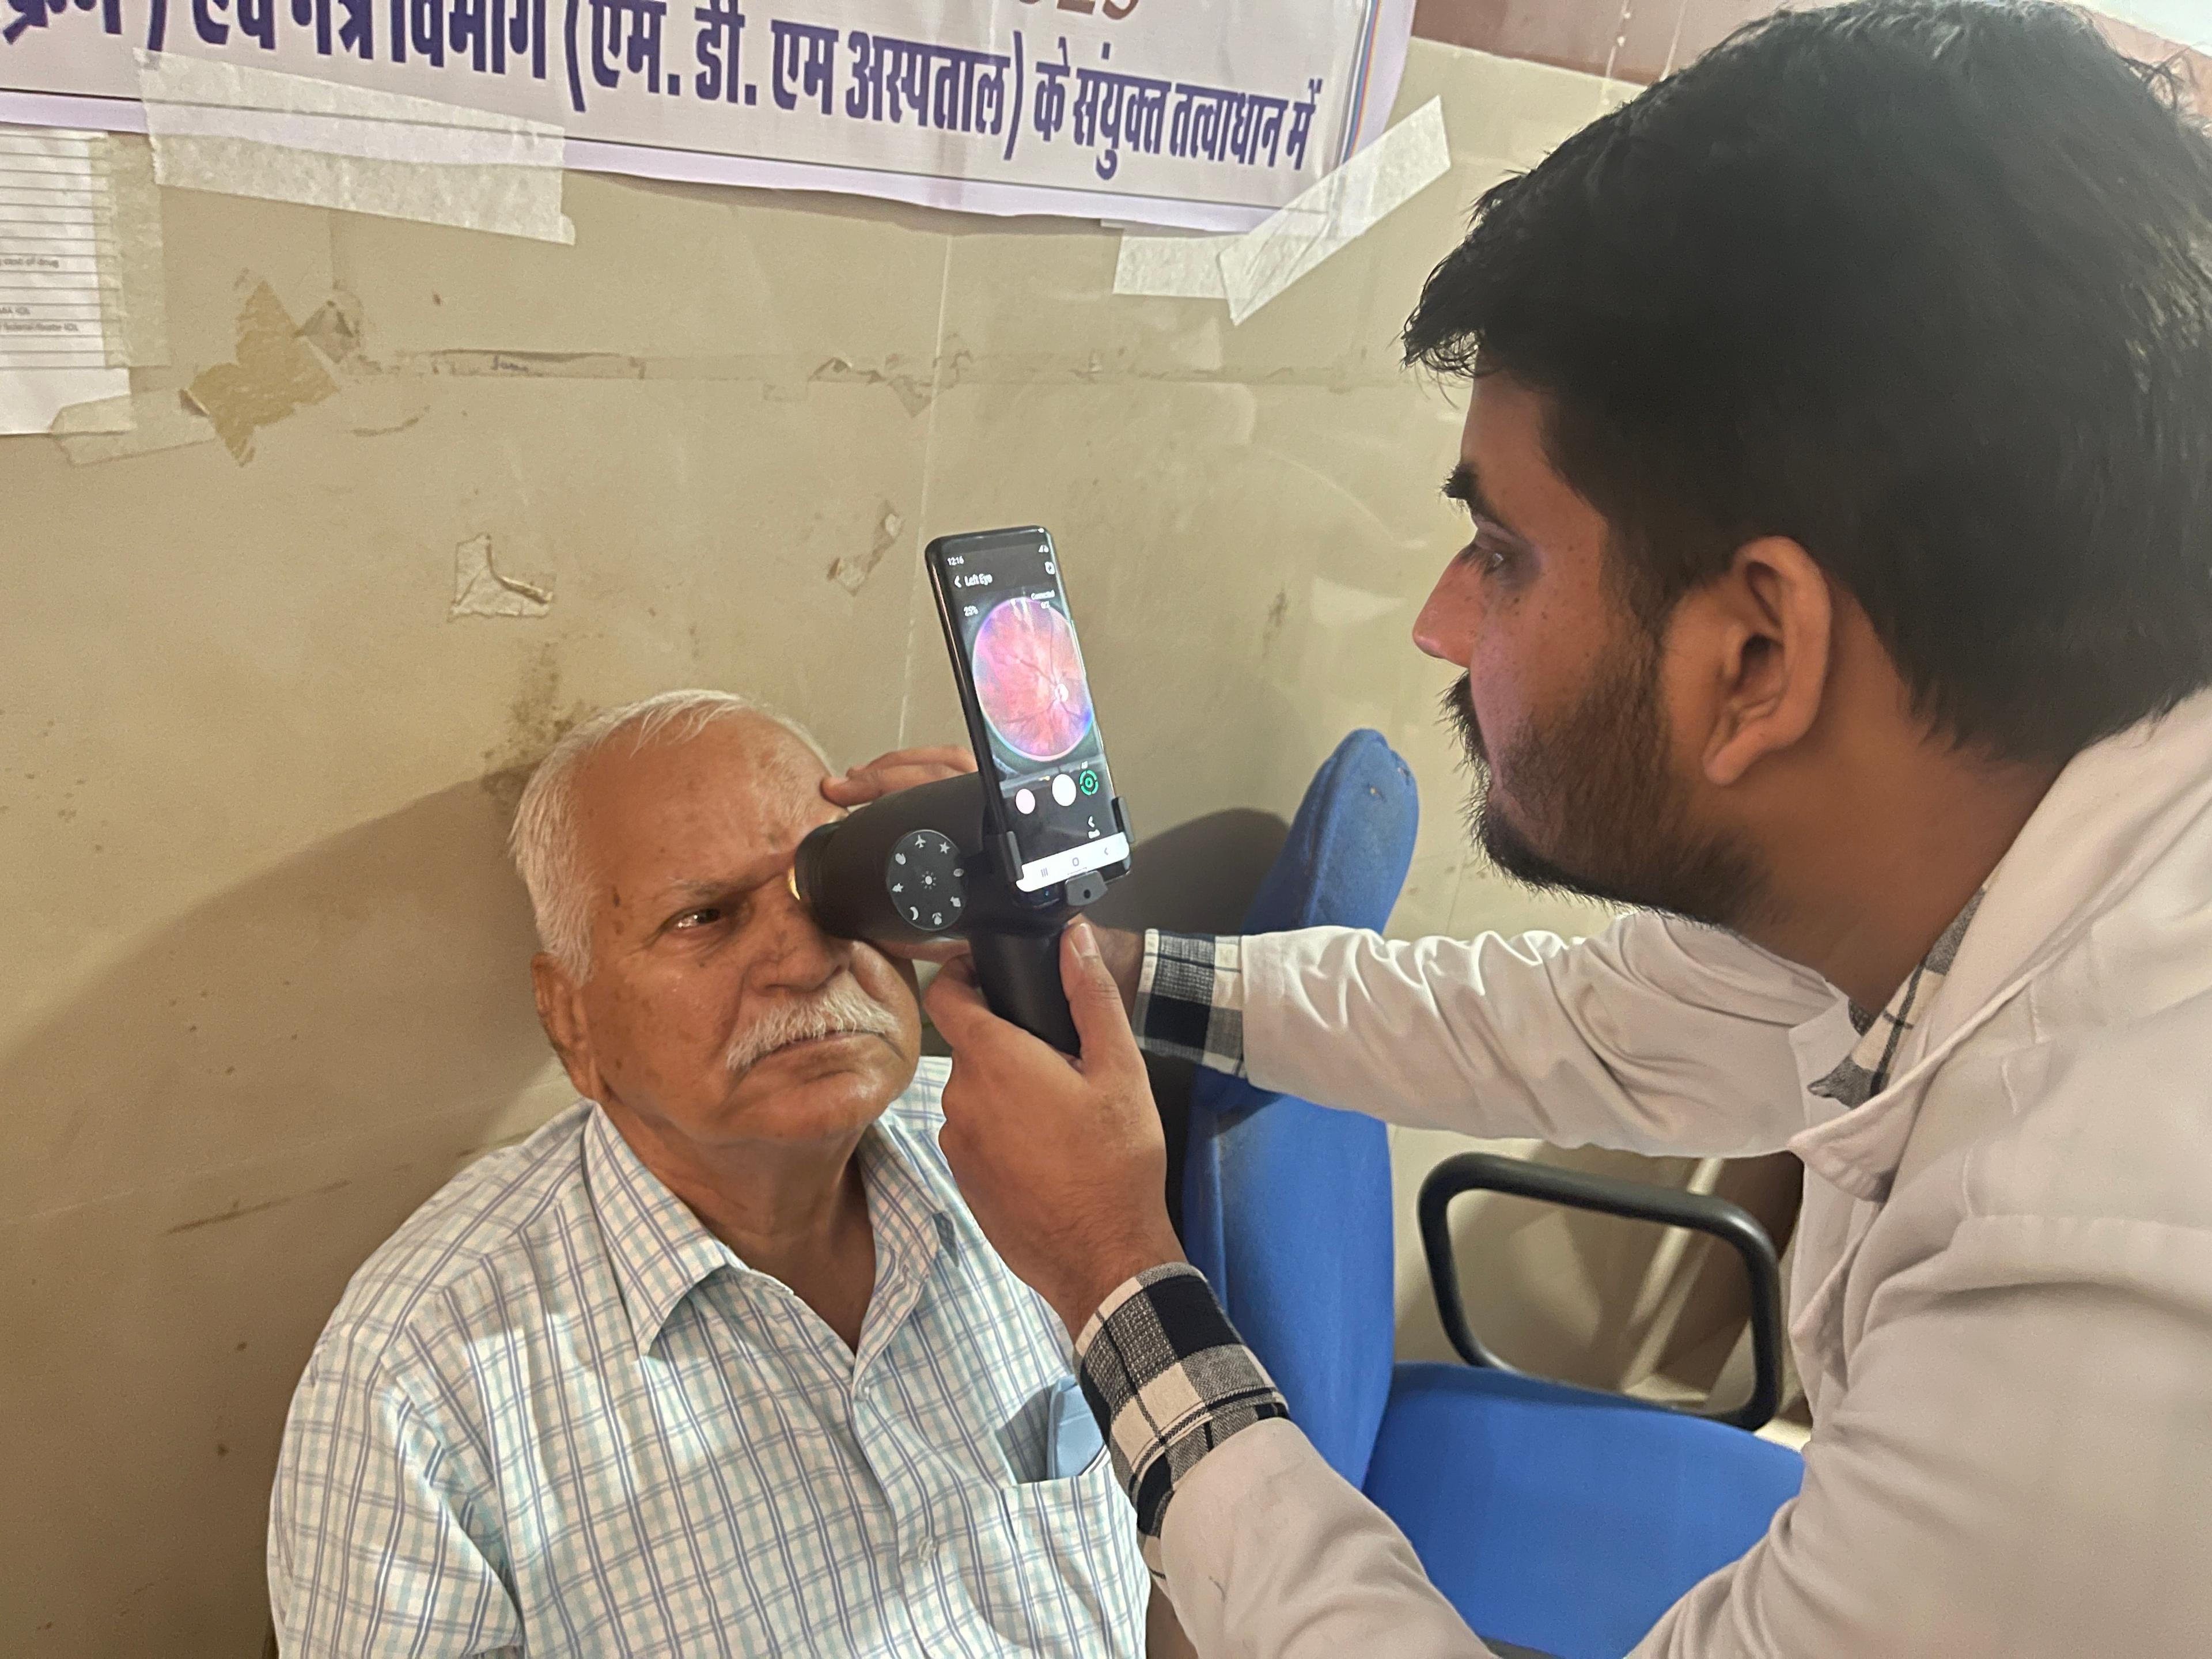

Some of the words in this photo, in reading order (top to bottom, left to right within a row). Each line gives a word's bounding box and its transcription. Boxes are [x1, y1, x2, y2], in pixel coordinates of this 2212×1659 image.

[771, 19, 839, 116] एम
[1033, 36, 1070, 142] के
[1286, 78, 1323, 171] में
